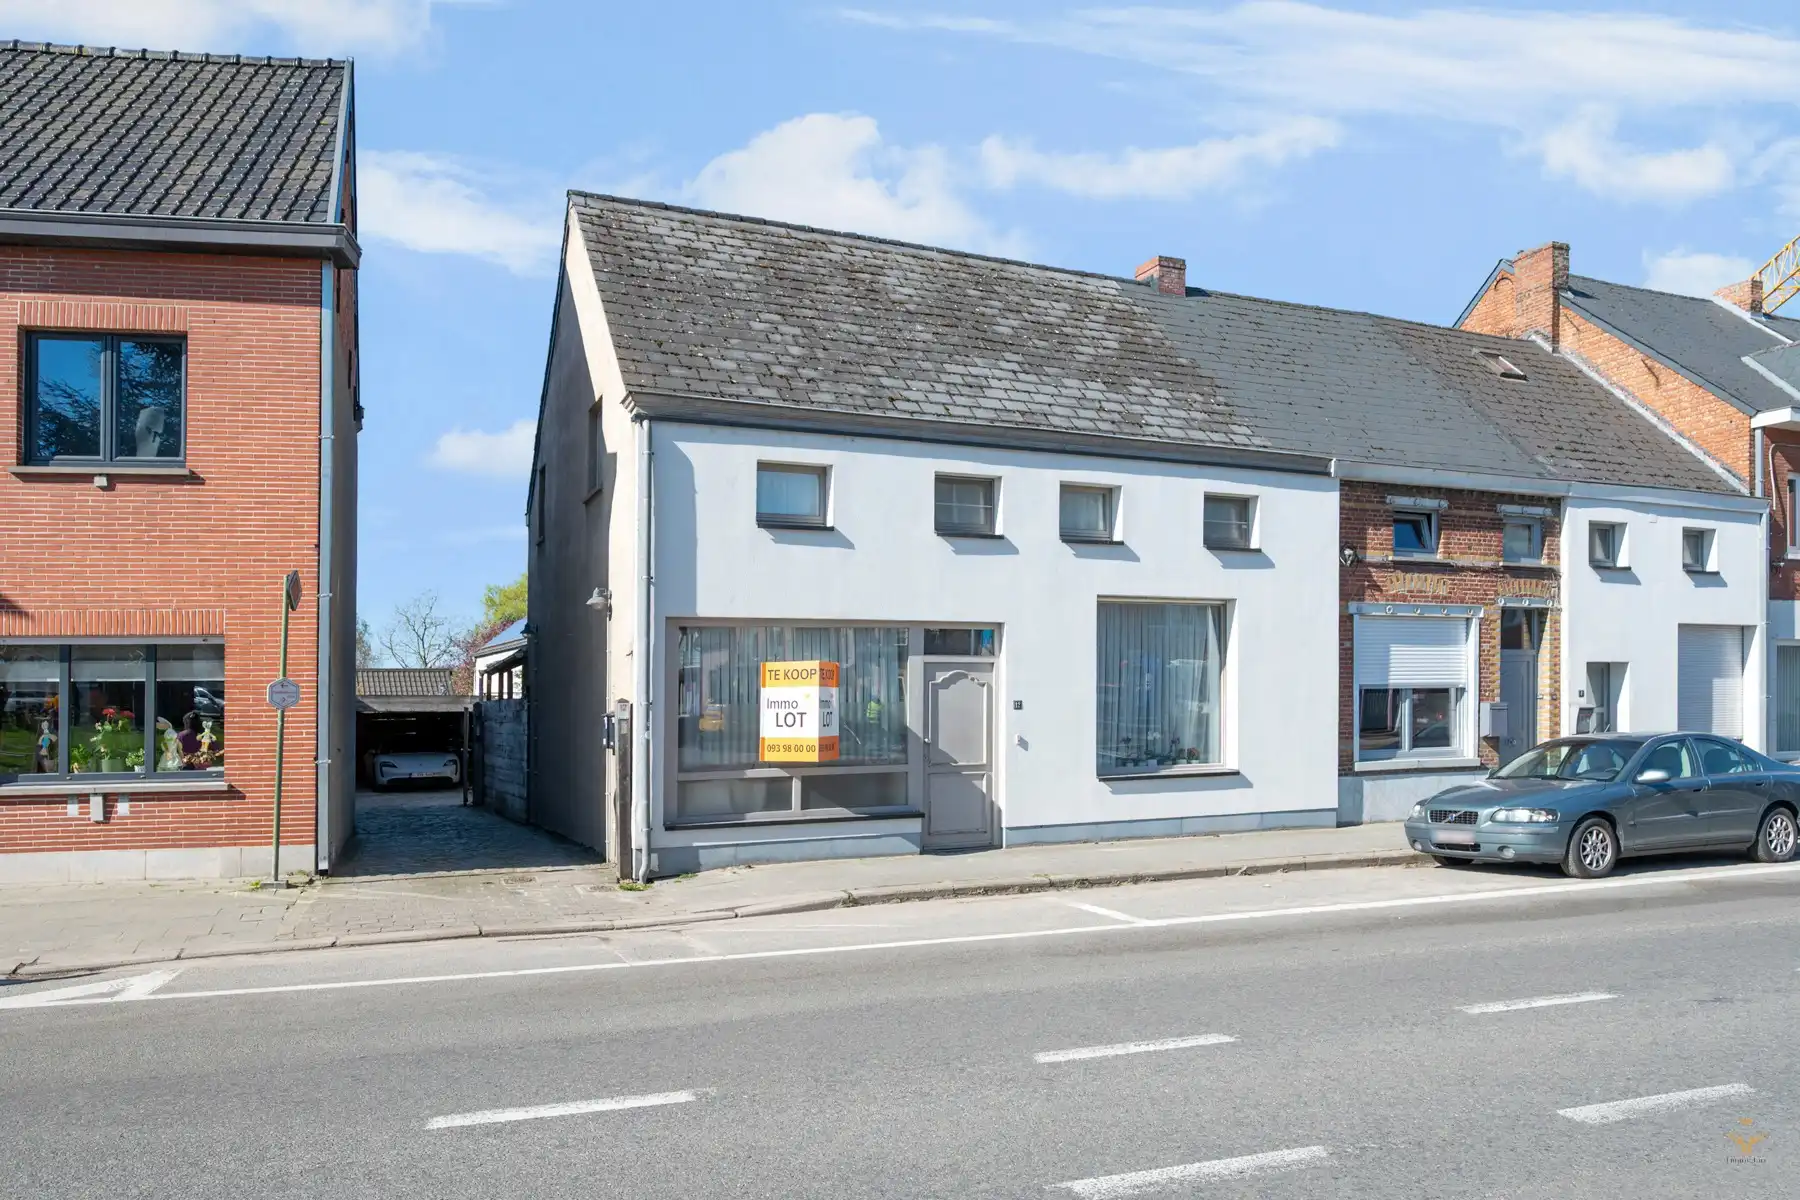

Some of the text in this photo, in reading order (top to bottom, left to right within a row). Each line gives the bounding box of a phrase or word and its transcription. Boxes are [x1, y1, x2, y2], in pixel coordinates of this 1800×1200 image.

[768, 668, 817, 680] TE KOOP
[767, 698, 799, 709] Immo
[776, 712, 807, 727] LOT
[822, 711, 833, 727] LOT
[767, 744, 780, 752] 093
[782, 744, 792, 753] 98
[794, 744, 804, 752] 00
[806, 744, 816, 752] 00
